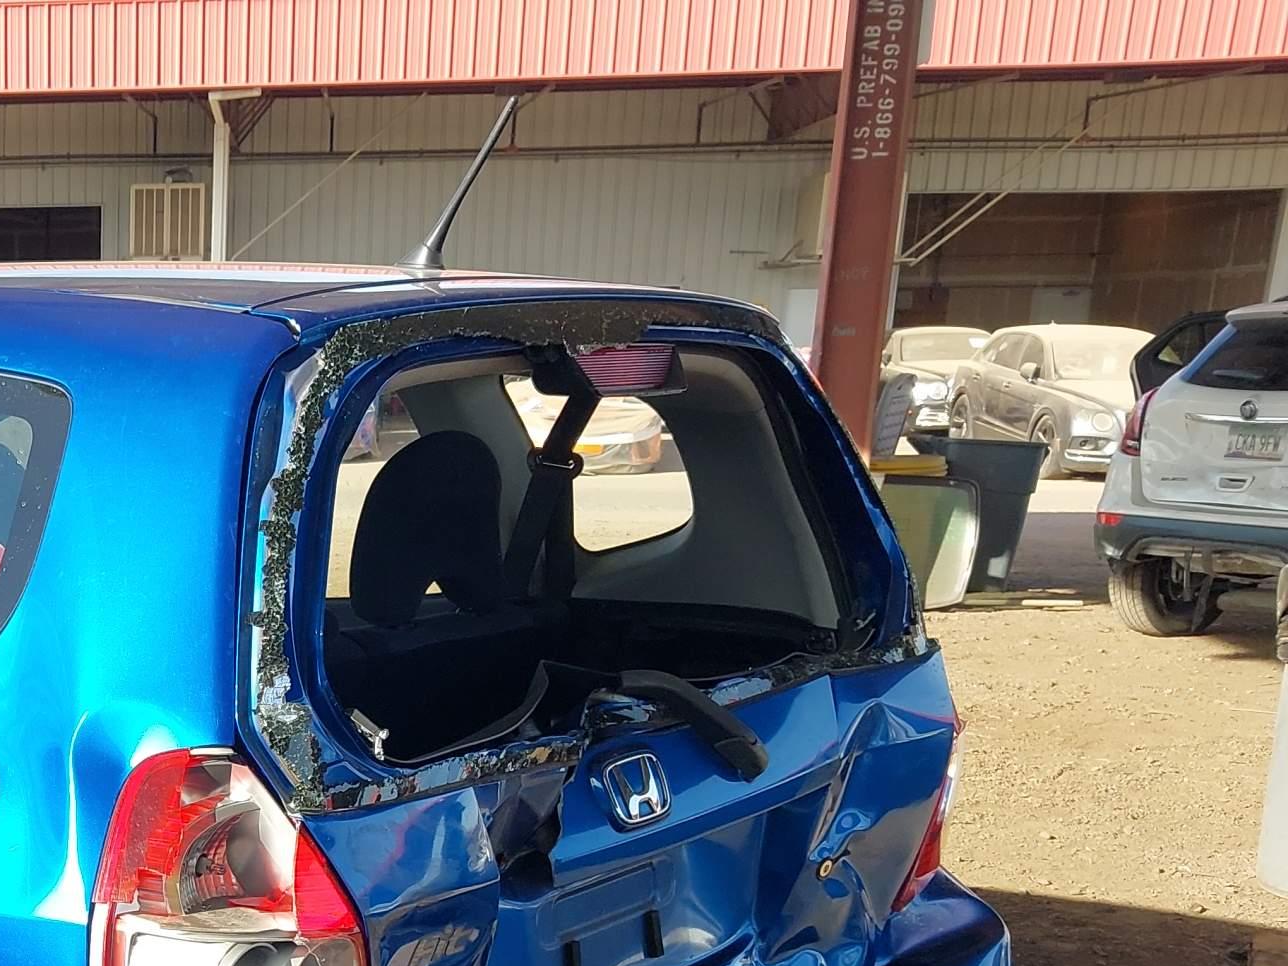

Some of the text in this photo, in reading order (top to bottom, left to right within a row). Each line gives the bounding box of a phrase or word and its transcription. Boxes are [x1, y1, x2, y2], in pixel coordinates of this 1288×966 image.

[856, 25, 882, 108] PREFAB
[872, 0, 905, 157] 1-866-799-09
[850, 119, 872, 160] U.S.
